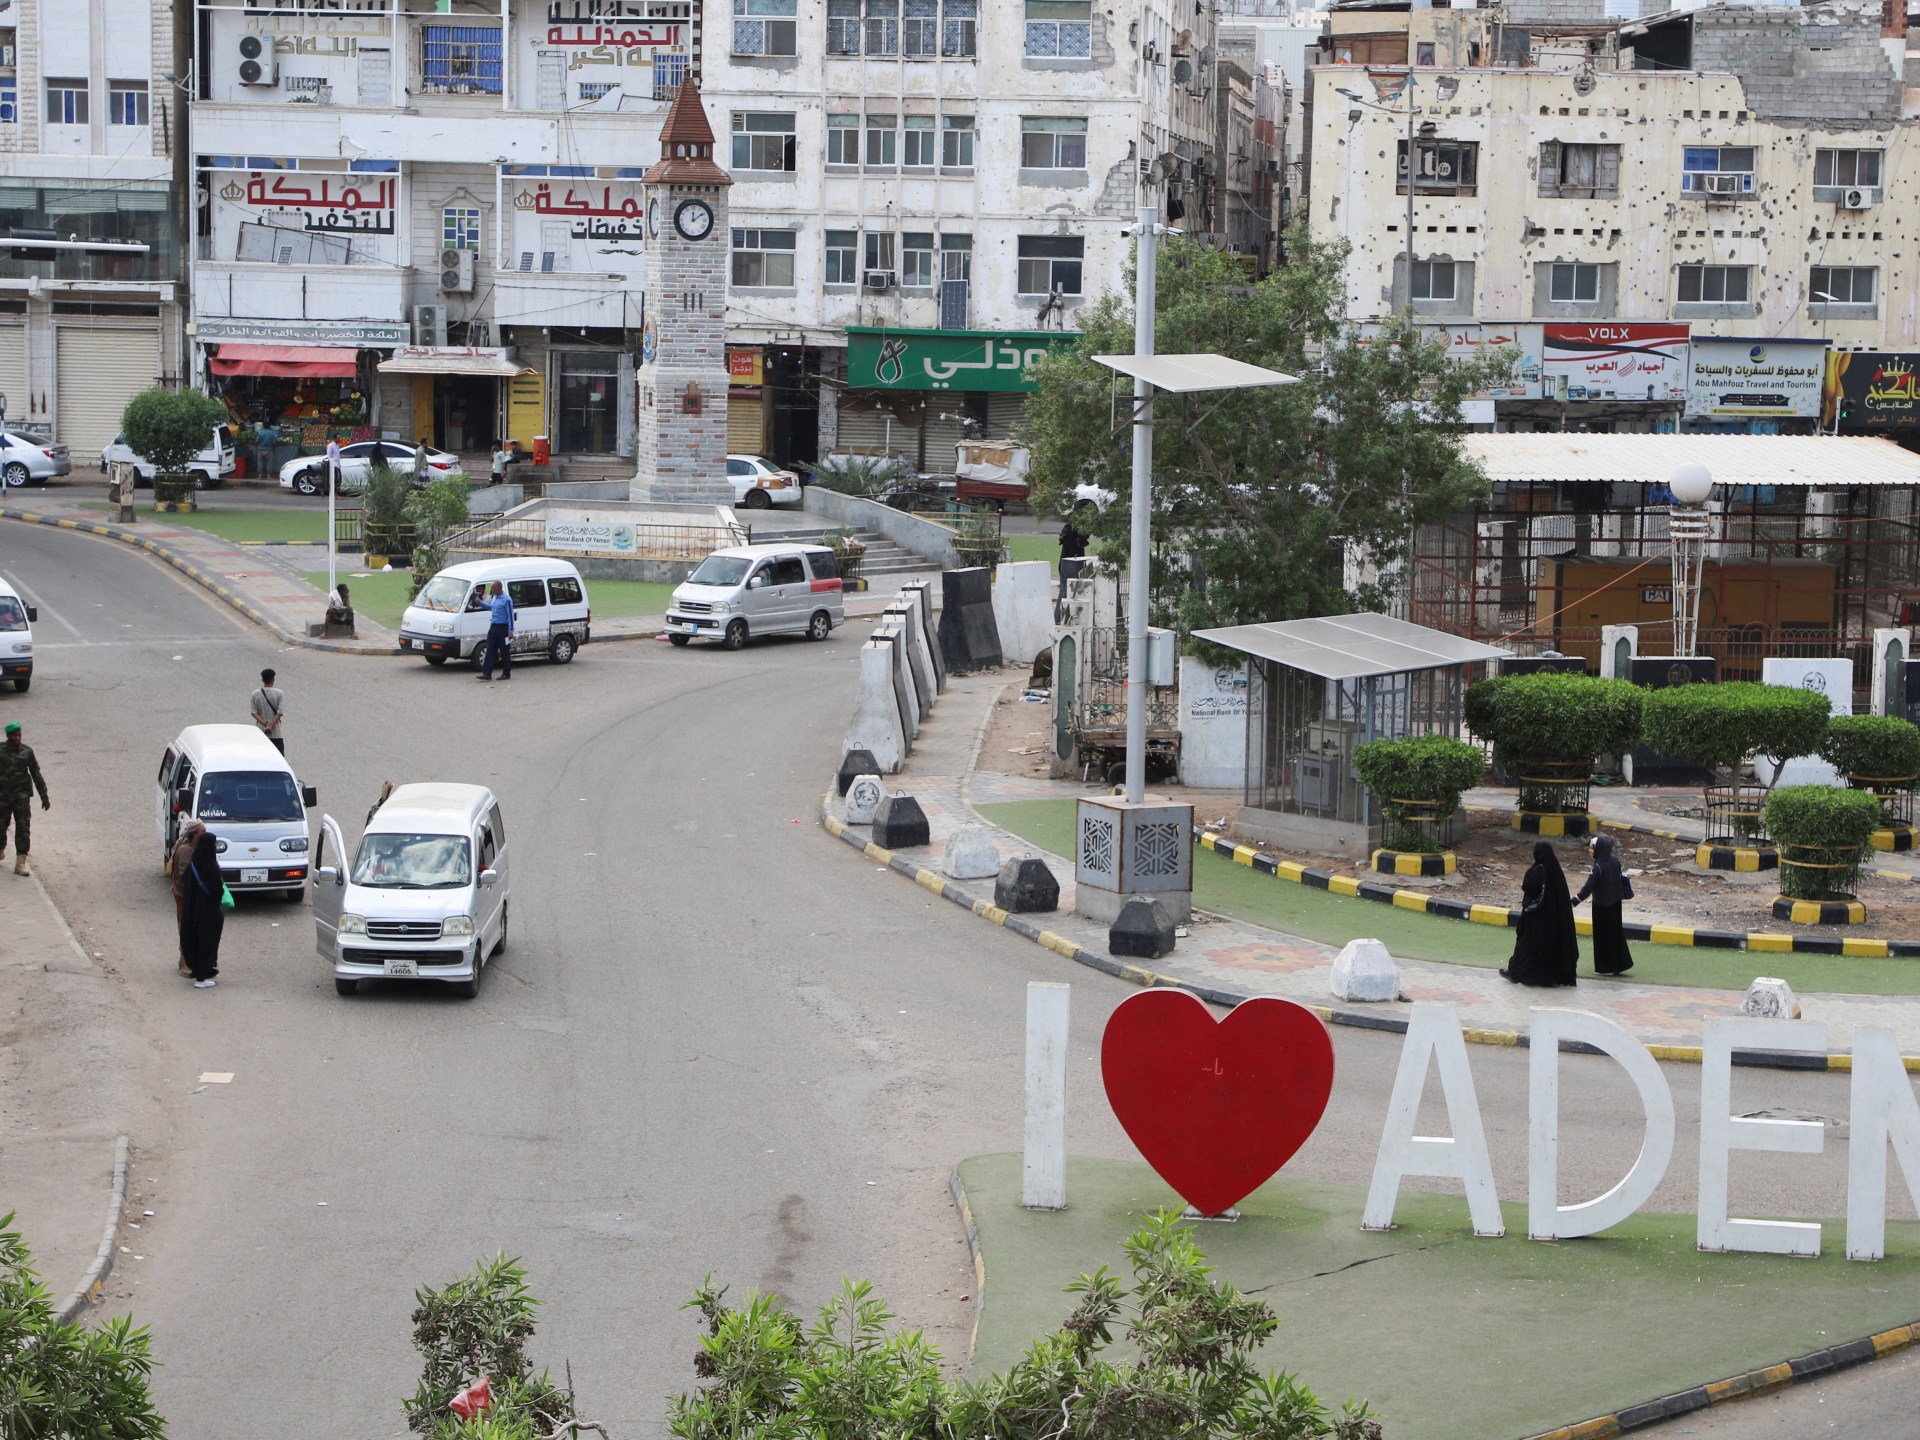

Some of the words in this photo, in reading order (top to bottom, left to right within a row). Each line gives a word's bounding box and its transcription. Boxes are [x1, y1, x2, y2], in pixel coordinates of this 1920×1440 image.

[568, 45, 622, 70] أكبر
[247, 172, 395, 210] الملكة
[1588, 327, 1629, 340] VOLX
[1585, 361, 1619, 375] العرب
[1637, 357, 1666, 375] أجياد
[1695, 364, 1732, 377] والسياحة
[1735, 366, 1774, 377] للسفريات
[1776, 366, 1805, 378] محفوظ
[1807, 364, 1819, 379] أبو
[1711, 379, 1744, 388] Mahfouz
[1746, 380, 1769, 388] Travel
[1786, 381, 1817, 389] Tourism
[1876, 401, 1913, 410] للملابس
[1023, 982, 1070, 1210] I
